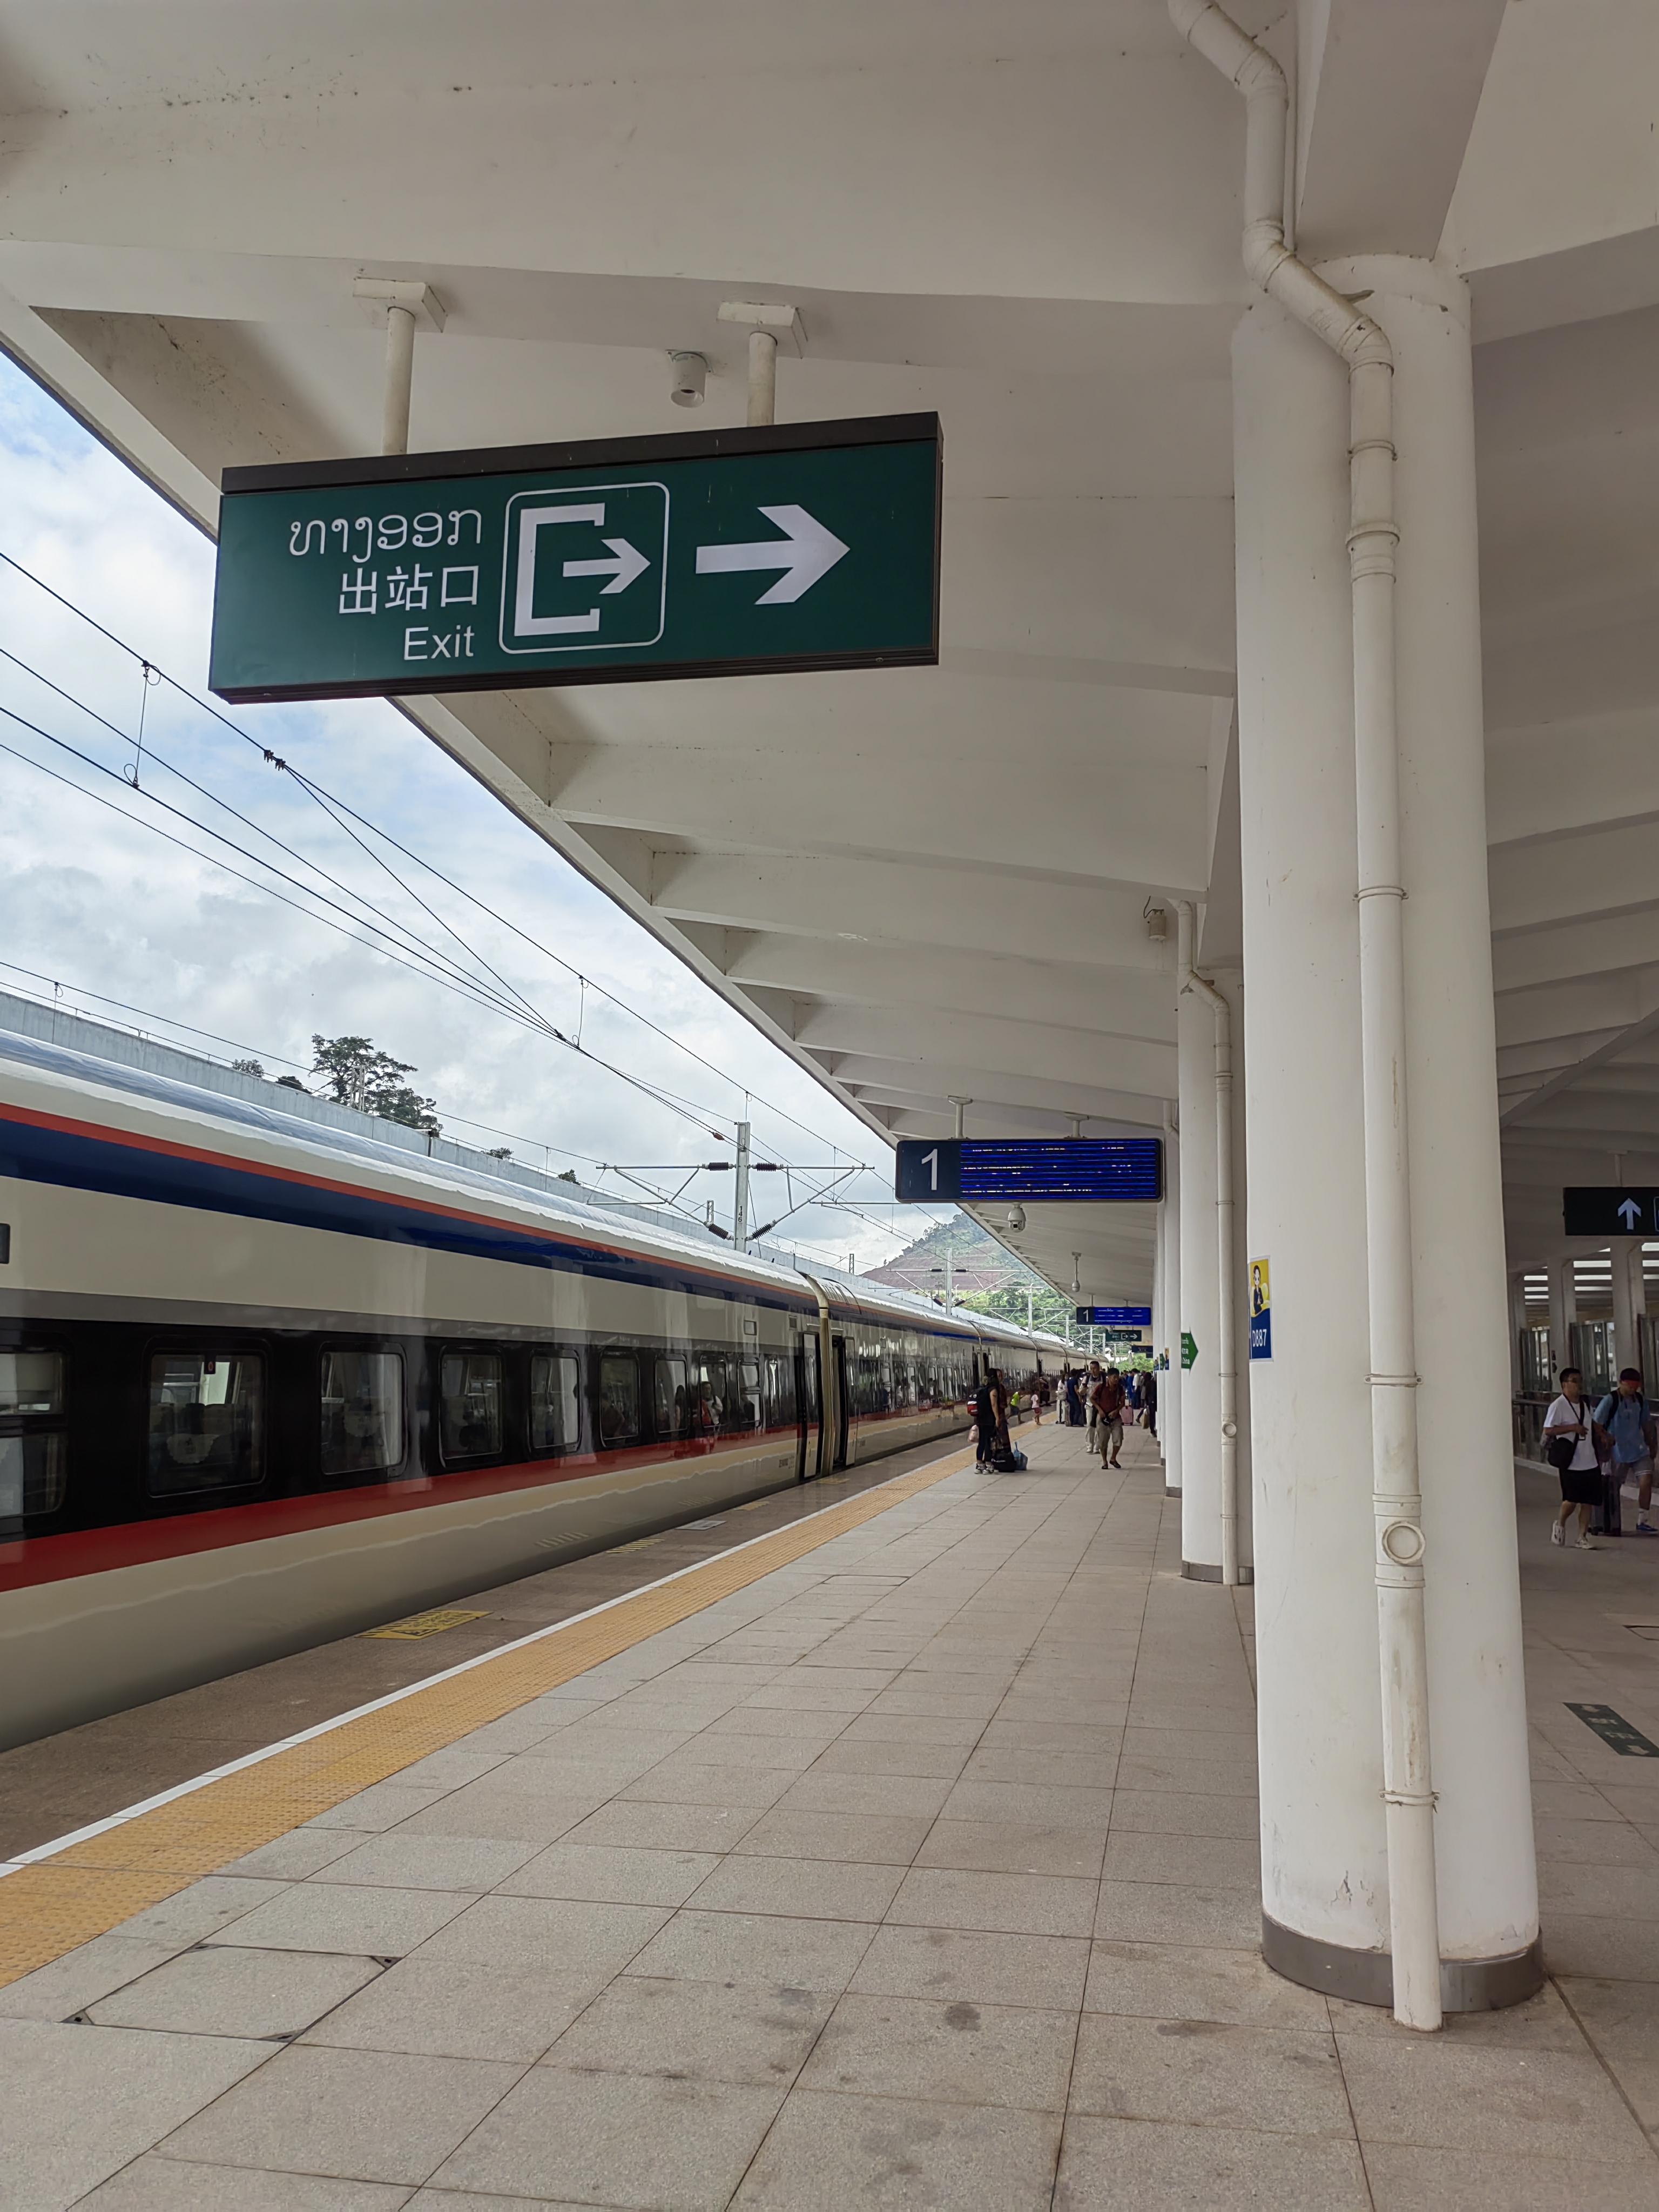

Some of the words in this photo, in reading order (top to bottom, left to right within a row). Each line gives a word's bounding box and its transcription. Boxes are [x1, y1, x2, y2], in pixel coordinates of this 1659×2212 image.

[289, 509, 482, 563] ທາງອອກ
[339, 563, 479, 615] 出站口
[404, 624, 475, 660] Exit
[921, 1149, 938, 1191] 1
[1083, 1309, 1089, 1322] 1
[1252, 1328, 1267, 1347] D887
